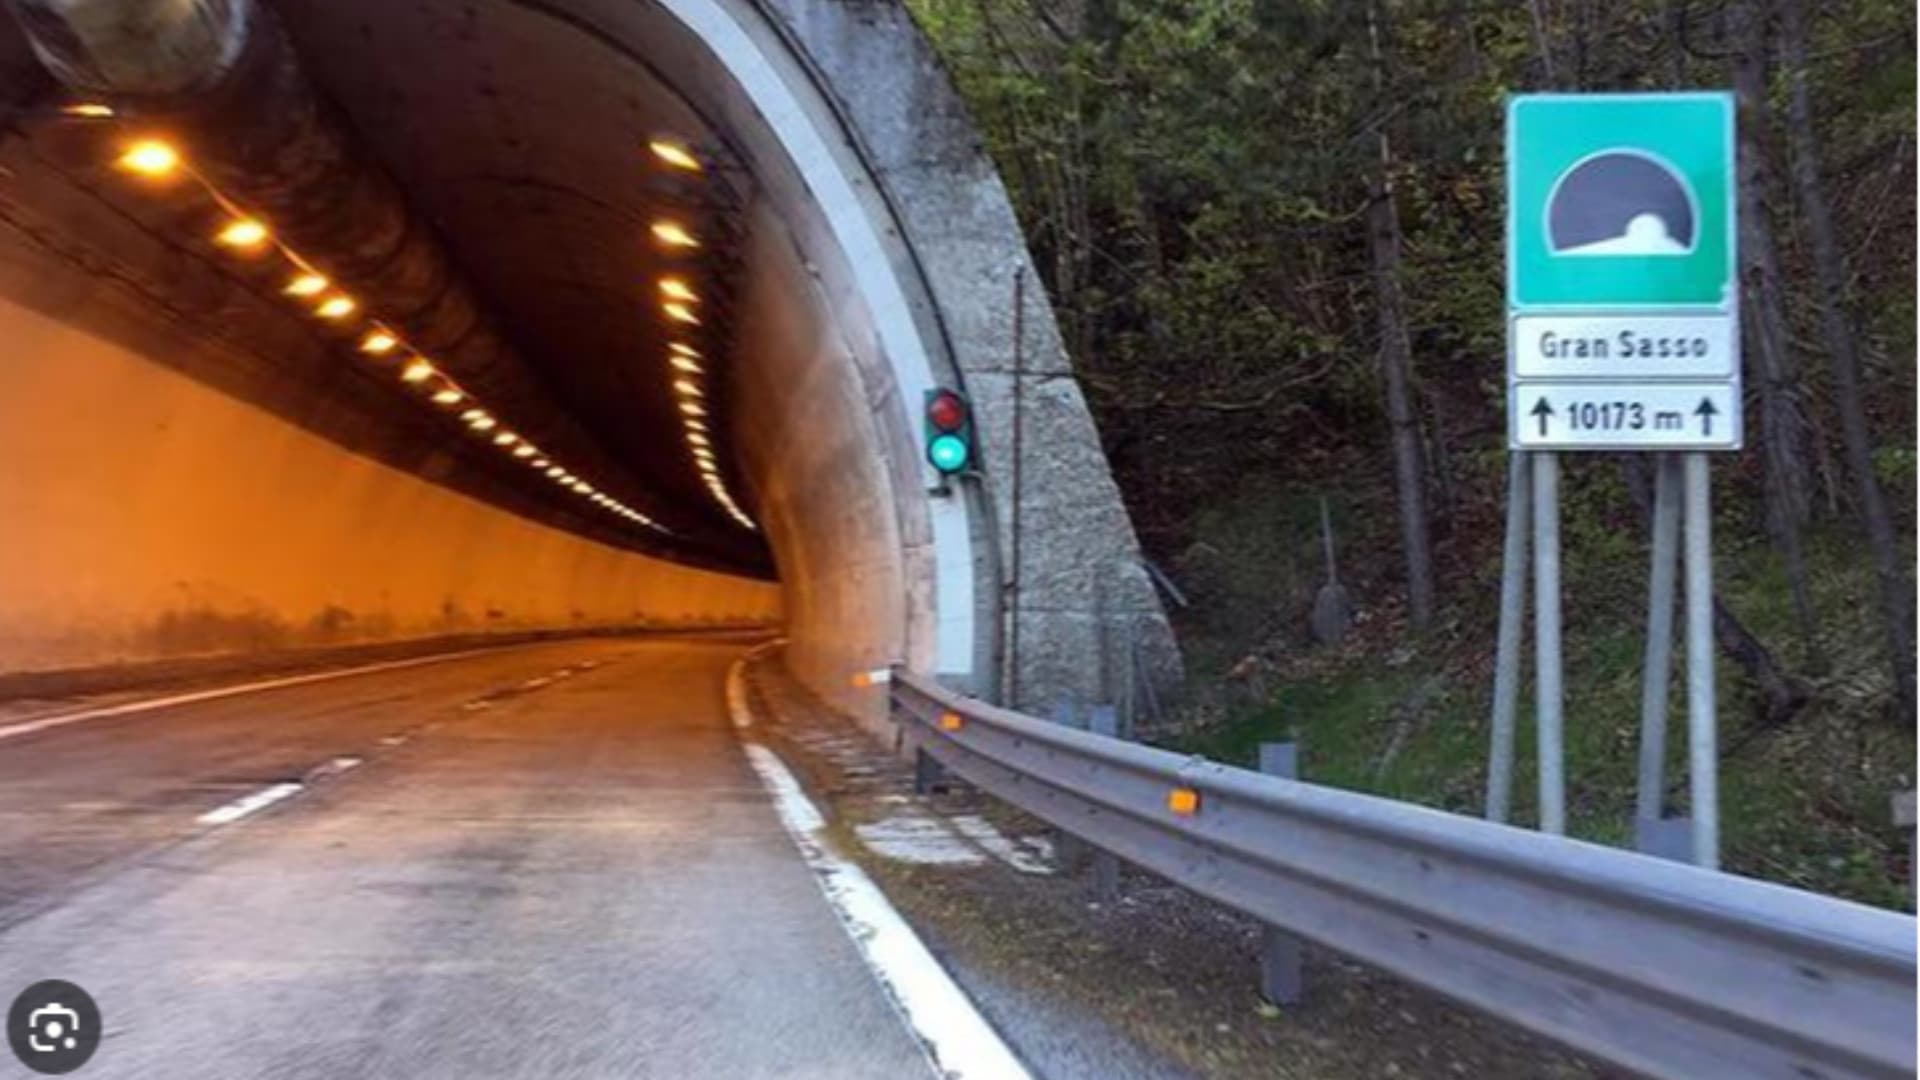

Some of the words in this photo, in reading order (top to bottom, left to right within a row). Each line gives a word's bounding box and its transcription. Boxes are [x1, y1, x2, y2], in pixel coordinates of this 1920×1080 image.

[1539, 330, 1609, 358] Gran
[1617, 330, 1708, 358] Sasso
[1567, 402, 1646, 430] 10173
[1653, 410, 1684, 430] m
